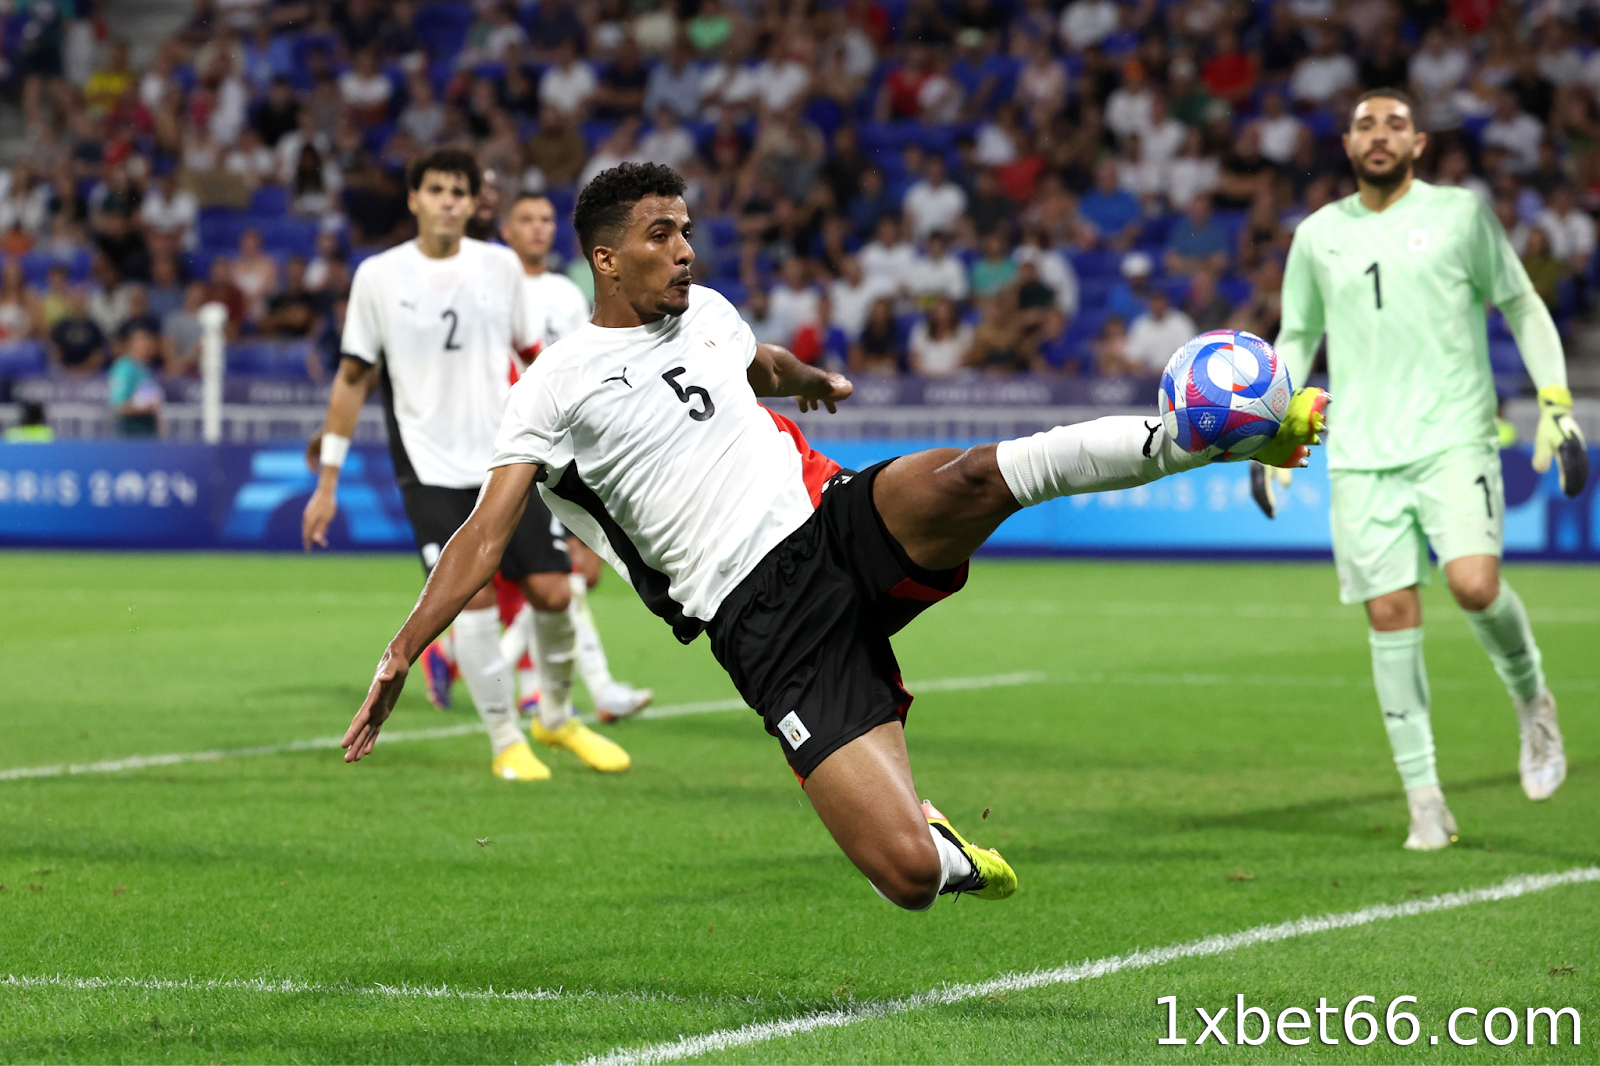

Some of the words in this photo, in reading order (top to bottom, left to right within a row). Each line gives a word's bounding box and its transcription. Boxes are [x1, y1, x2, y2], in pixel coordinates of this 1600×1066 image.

[1365, 263, 1382, 309] 1
[441, 309, 461, 350] 2
[661, 366, 716, 421] 5
[1475, 474, 1494, 518] 1
